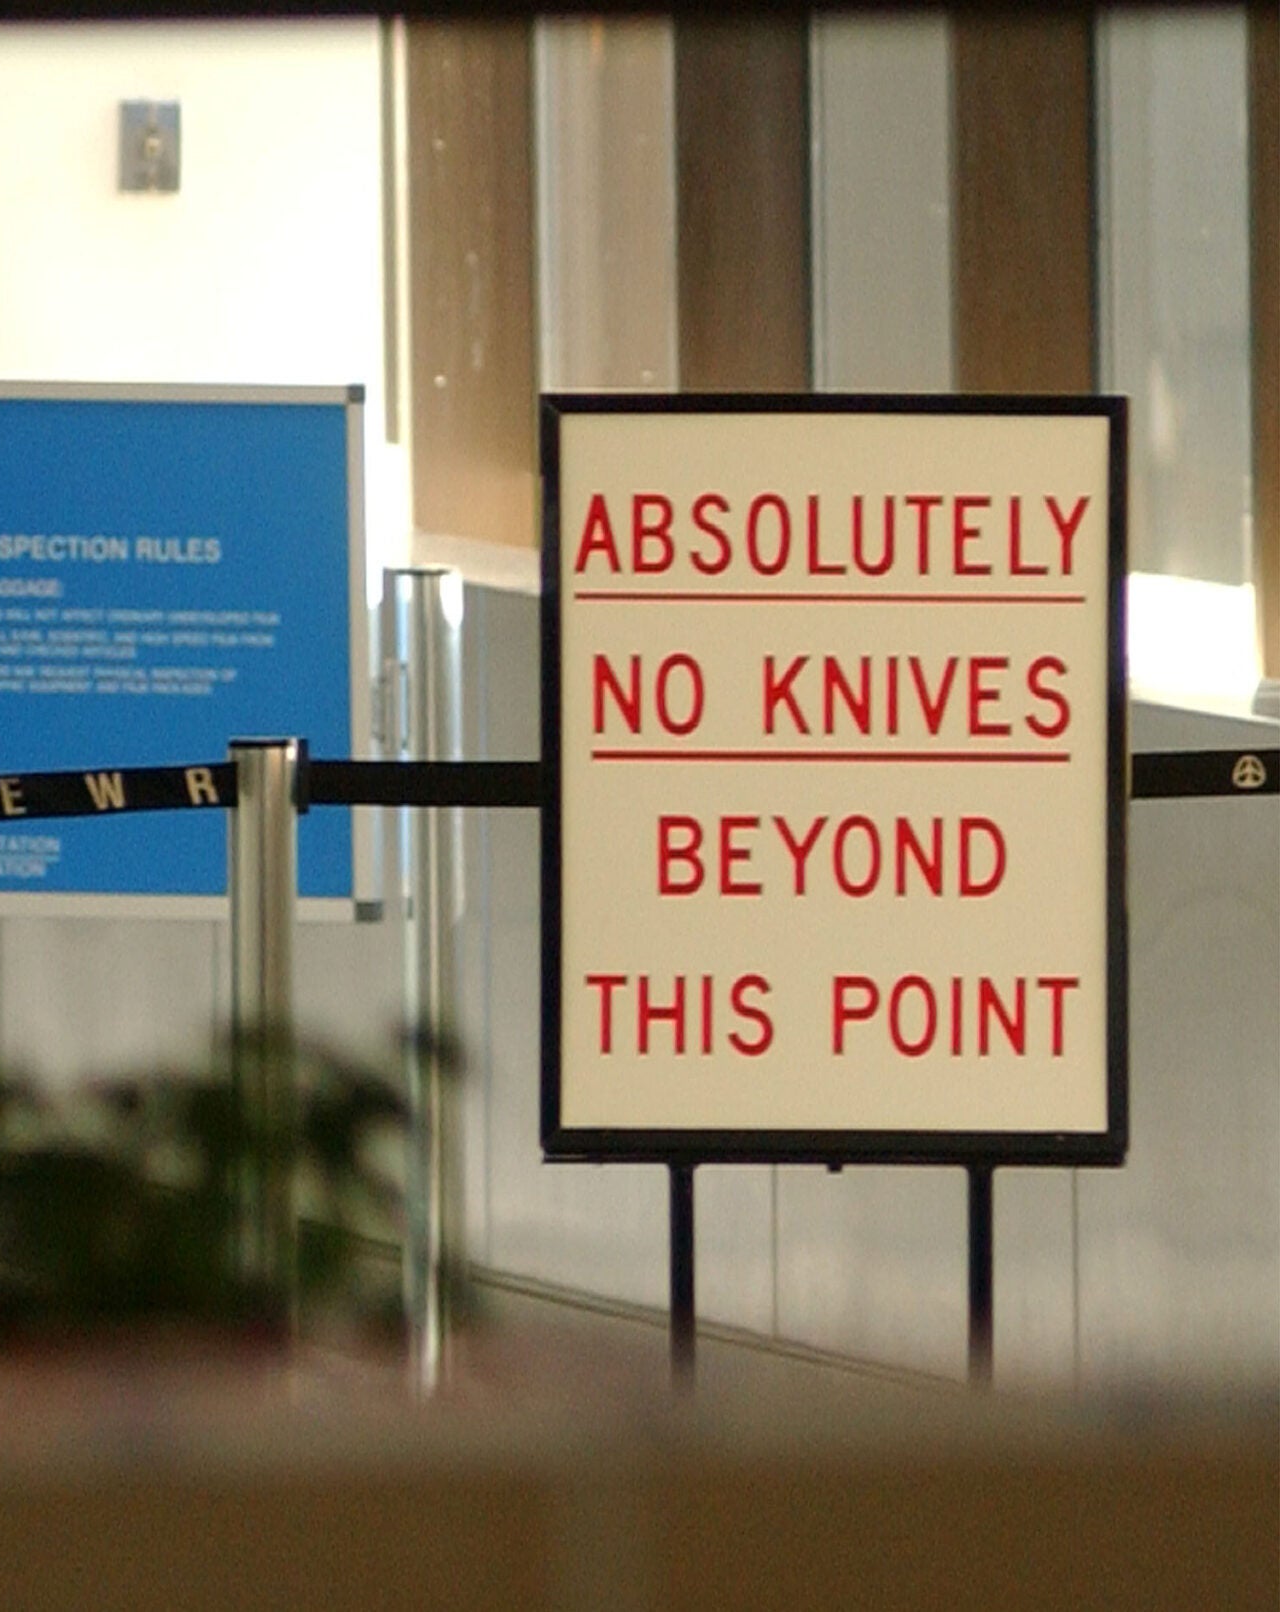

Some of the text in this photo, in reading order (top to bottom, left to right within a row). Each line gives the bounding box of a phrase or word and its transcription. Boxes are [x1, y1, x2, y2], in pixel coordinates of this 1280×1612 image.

[135, 536, 222, 564] RULES
[575, 493, 1090, 578] ABSOLUTELY
[593, 653, 1071, 741] NO KNIVES
[657, 815, 1007, 899] BEYOND
[589, 974, 1077, 1059] THIS POINT
